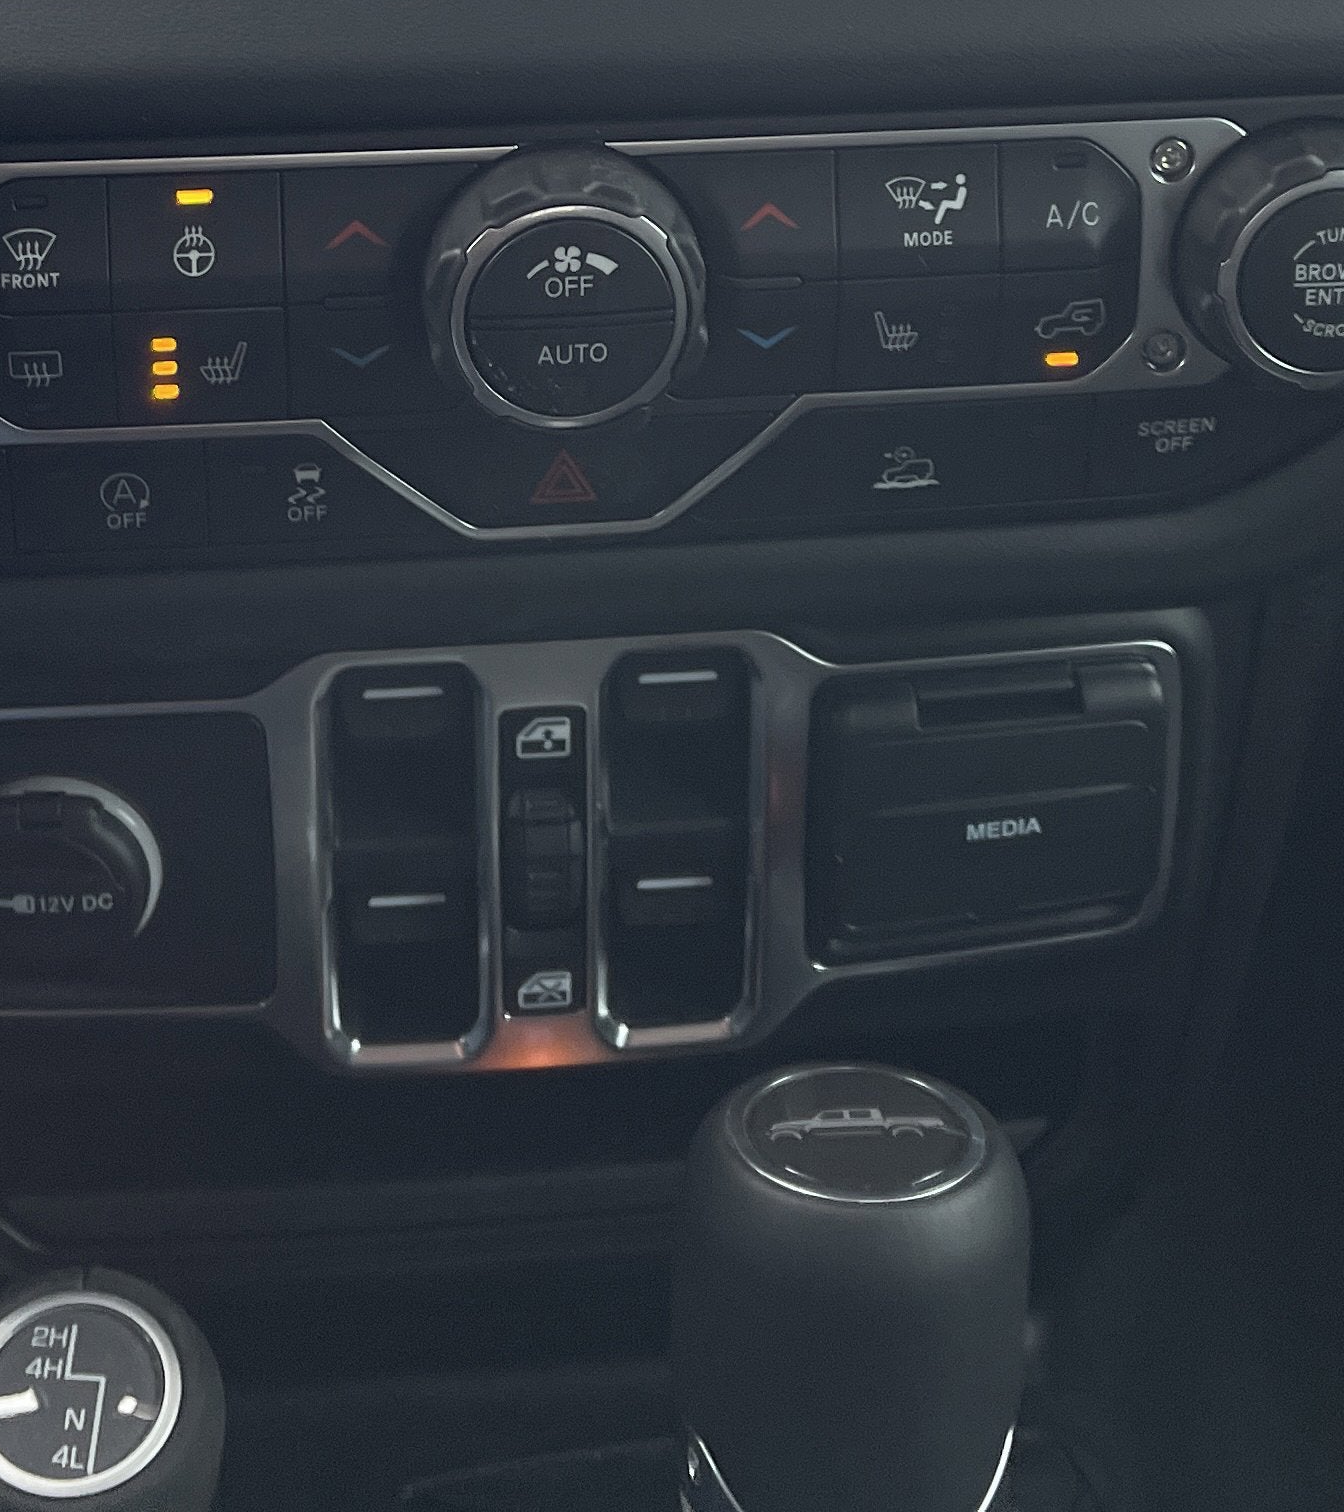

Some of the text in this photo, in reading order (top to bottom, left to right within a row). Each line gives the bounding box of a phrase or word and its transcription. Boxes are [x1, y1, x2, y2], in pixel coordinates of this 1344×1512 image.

[1046, 199, 1101, 230] A/C
[903, 229, 954, 248] MODE
[0, 271, 60, 289] FRONT
[543, 275, 595, 300] OFF
[537, 341, 609, 366] AUTO
[1137, 417, 1217, 441] SCREEN
[1154, 434, 1195, 455] OFF
[106, 511, 147, 530] OFF
[287, 504, 328, 523] OFF
[966, 817, 1042, 841] MEDIA
[39, 891, 114, 913] 12V DC
[31, 1325, 69, 1348] 2H
[25, 1357, 64, 1379] 4H
[64, 1407, 86, 1431] N
[51, 1445, 86, 1471] 4L
